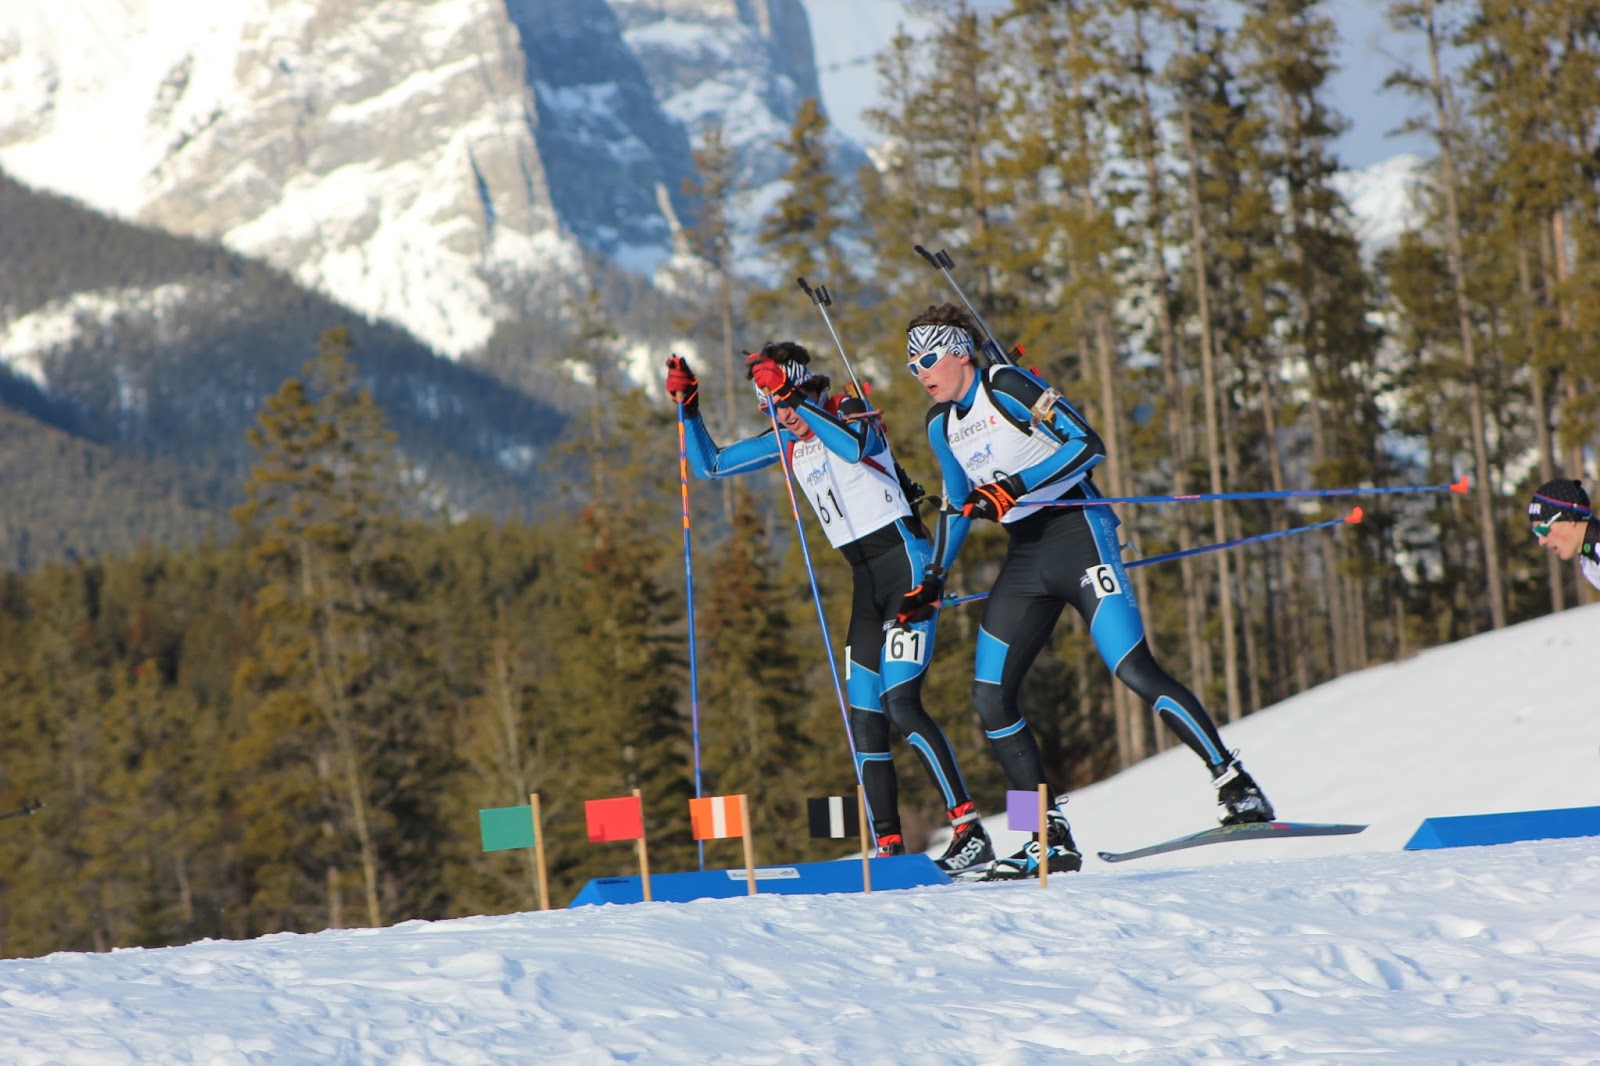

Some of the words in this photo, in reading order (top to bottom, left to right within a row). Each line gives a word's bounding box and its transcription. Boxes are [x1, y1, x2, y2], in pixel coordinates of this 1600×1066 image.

[816, 488, 844, 525] 61
[1096, 566, 1115, 593] 6
[890, 631, 921, 661] 61
[944, 836, 986, 870] ROSSI
